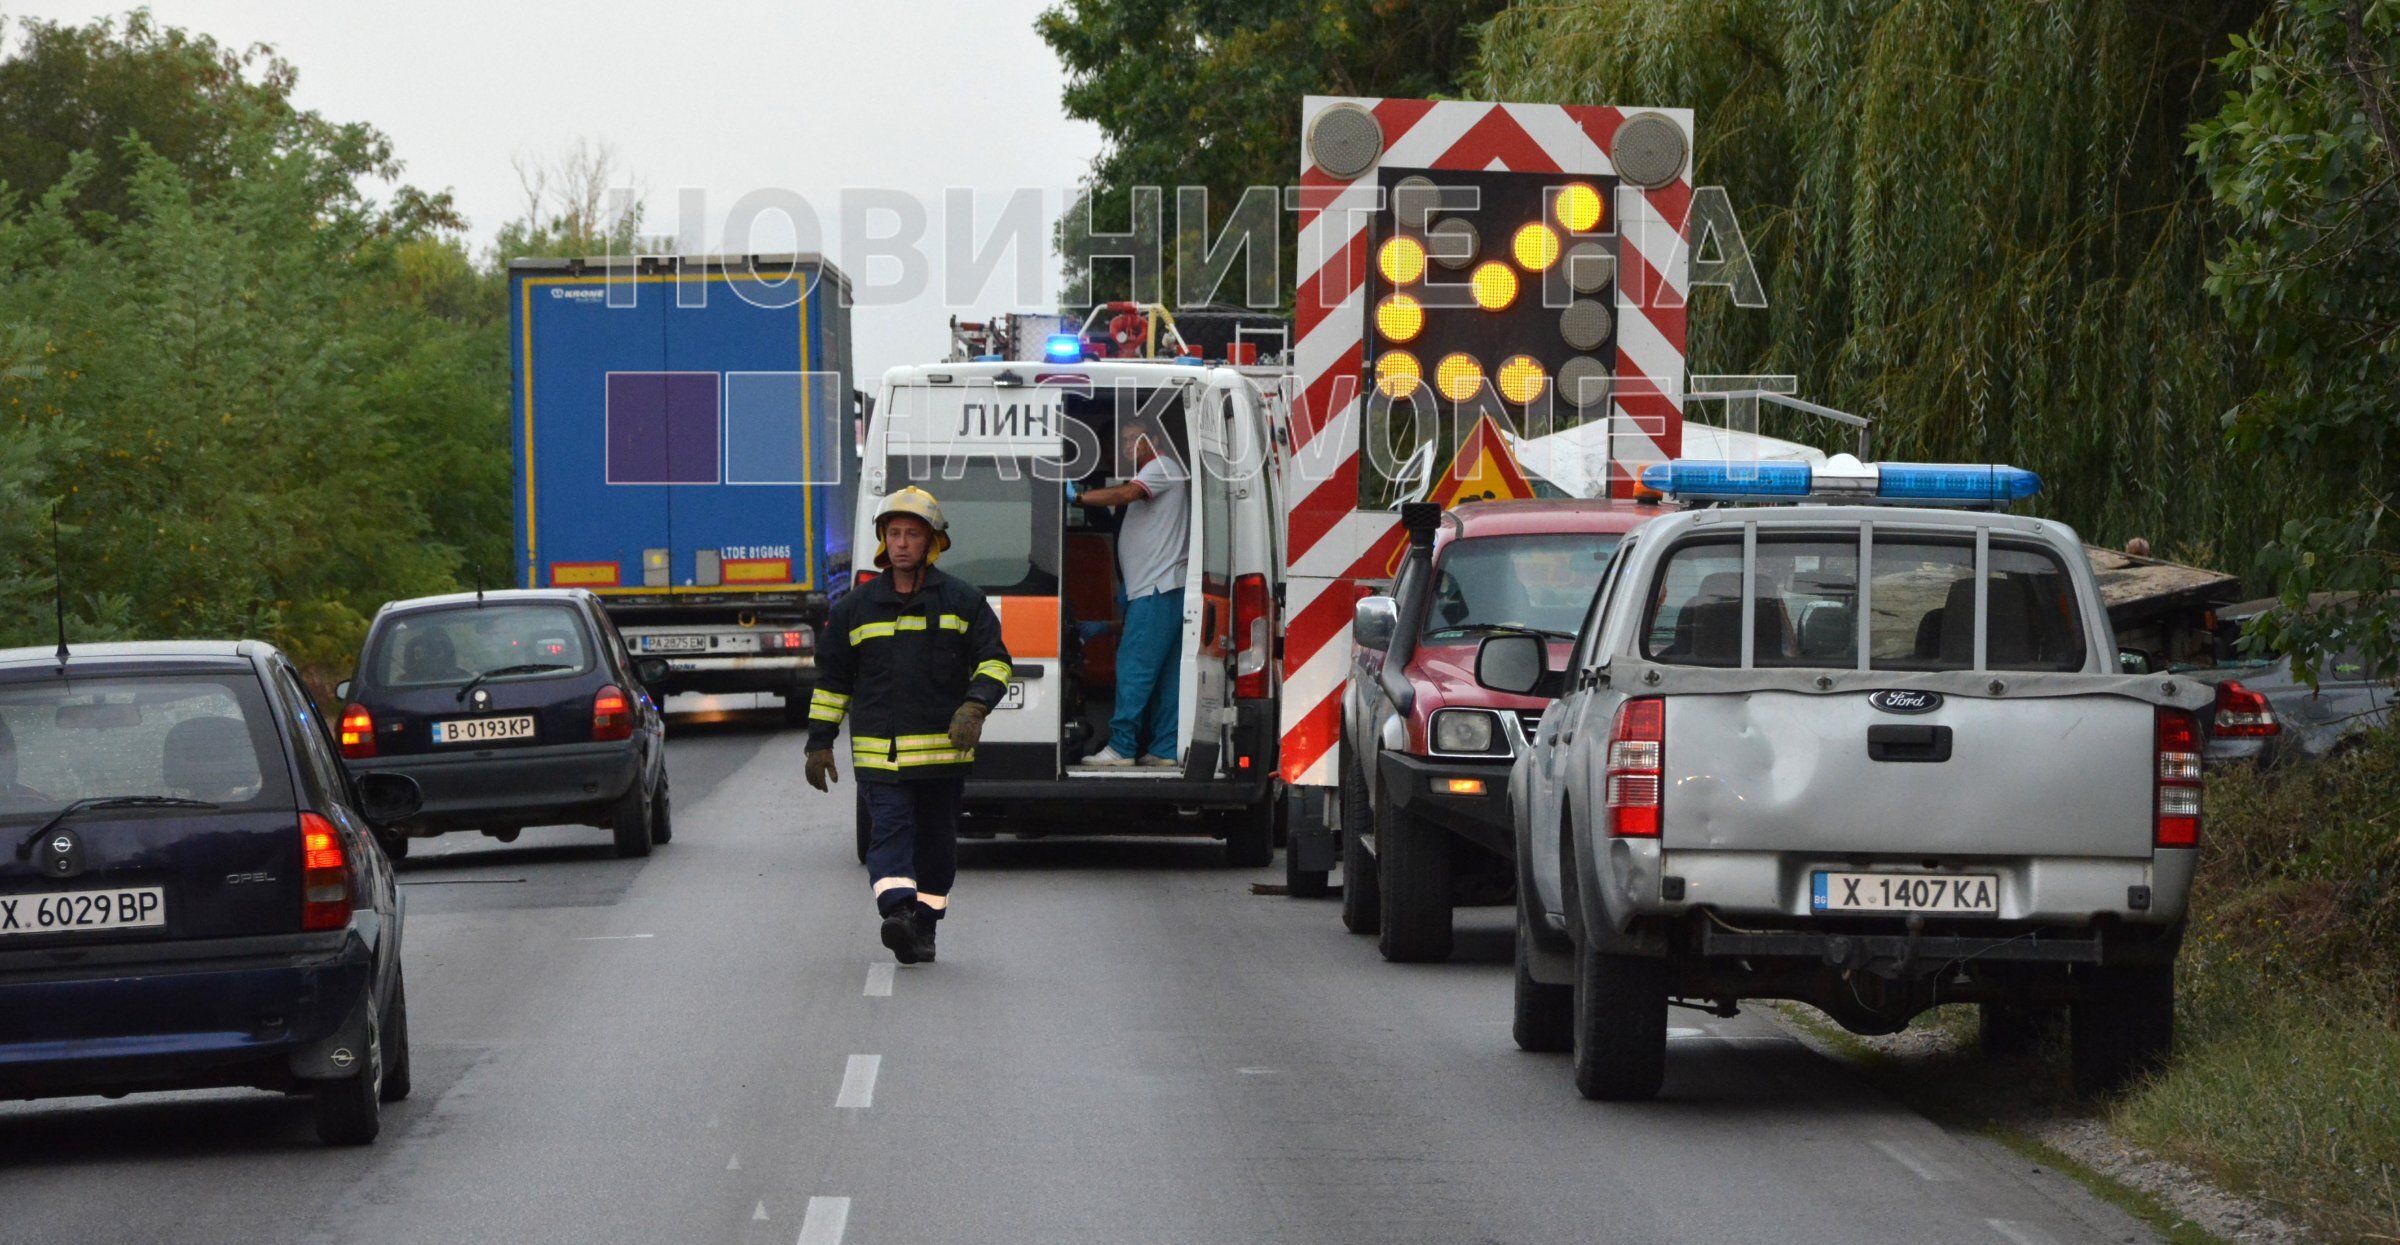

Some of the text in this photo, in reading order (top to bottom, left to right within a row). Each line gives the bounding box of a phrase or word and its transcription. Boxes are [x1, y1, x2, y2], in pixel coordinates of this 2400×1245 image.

[565, 290, 604, 298] KRONE
[959, 403, 1063, 438] ЛИН
[721, 546, 746, 559] LTDE
[1886, 691, 1924, 706] Ford
[226, 872, 277, 884] OPEL
